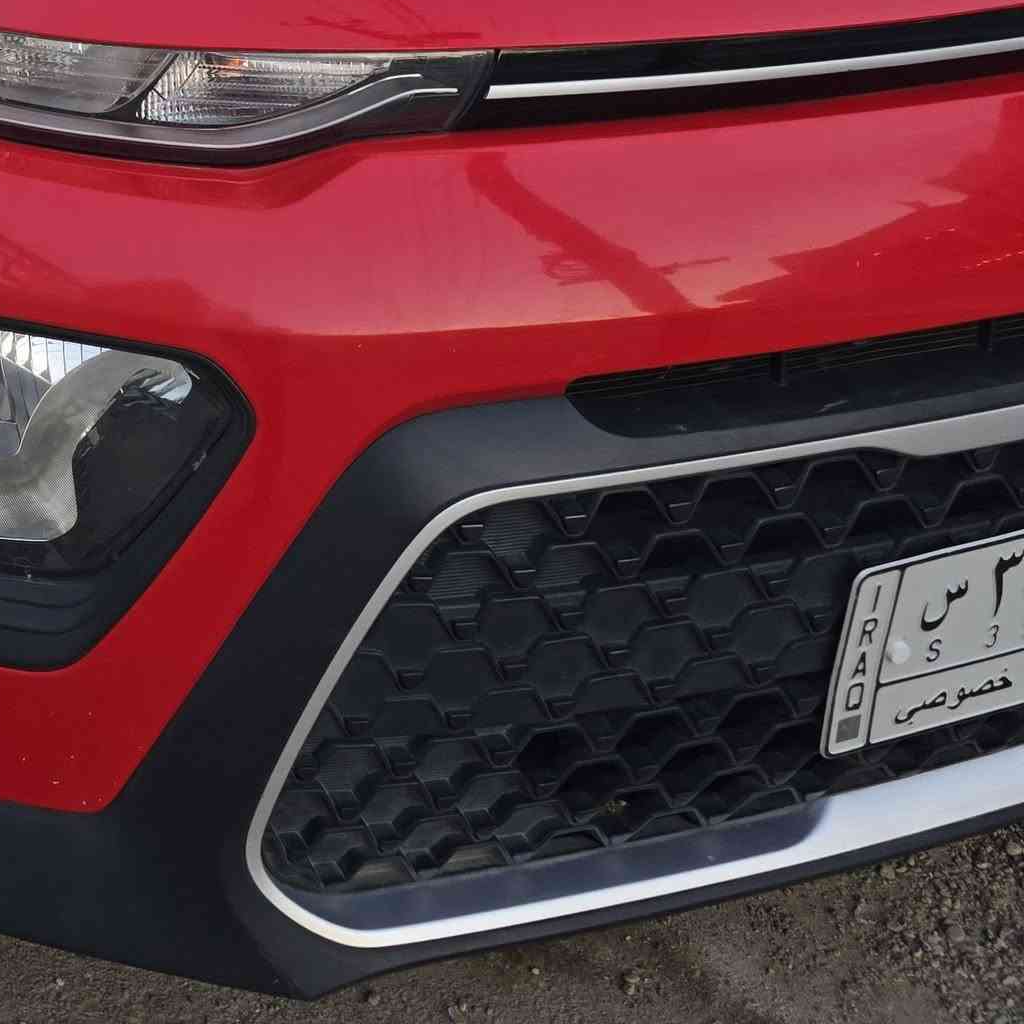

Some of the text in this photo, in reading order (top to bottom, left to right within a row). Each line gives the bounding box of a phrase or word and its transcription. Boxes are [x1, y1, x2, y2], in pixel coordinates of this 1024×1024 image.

[845, 584, 882, 711] IRAQ
[926, 624, 1000, 662] S 3
